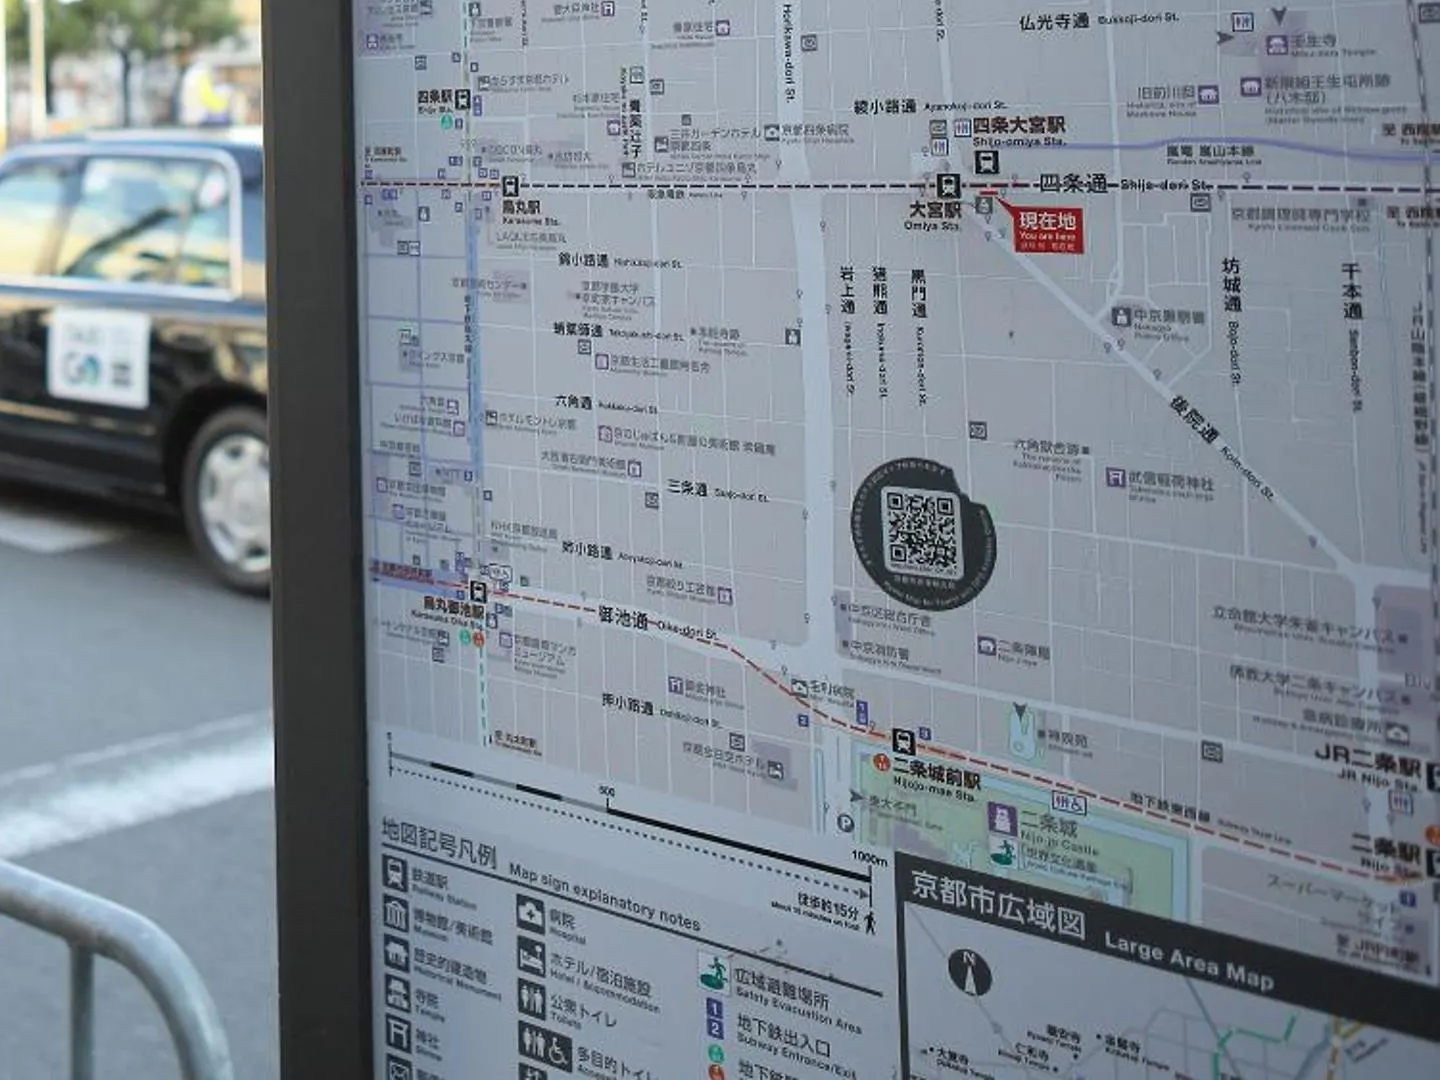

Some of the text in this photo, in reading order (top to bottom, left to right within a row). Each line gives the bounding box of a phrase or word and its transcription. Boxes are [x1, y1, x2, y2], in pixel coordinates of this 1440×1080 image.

[1019, 11, 1090, 32] 仏光寺通
[972, 115, 1067, 136] 四条大宮駅
[1039, 172, 1110, 195] 四条通
[909, 200, 962, 220] 大宮駅
[1018, 211, 1077, 230] 現在地
[1221, 256, 1243, 314] 坊城通
[1341, 262, 1364, 321] 千本通
[1169, 394, 1221, 446] 後院通
[666, 478, 708, 498] 三条通
[598, 603, 650, 632] 御池通
[893, 756, 982, 791] 二条城前駅
[1314, 742, 1423, 780] JR二条駅
[1020, 809, 1079, 839] 二条城
[381, 815, 498, 870] 地図記号凡例
[852, 849, 888, 868] 1000m
[1350, 831, 1422, 866] 二条駅
[510, 861, 702, 932] Map sign explanatory notes
[911, 870, 1086, 941] 京都市広域図
[962, 950, 977, 967] N
[1104, 930, 1276, 992] Large Area Map
[734, 967, 830, 1012] 広域避難場所
[737, 1012, 831, 1059] 地下鉄出入口
